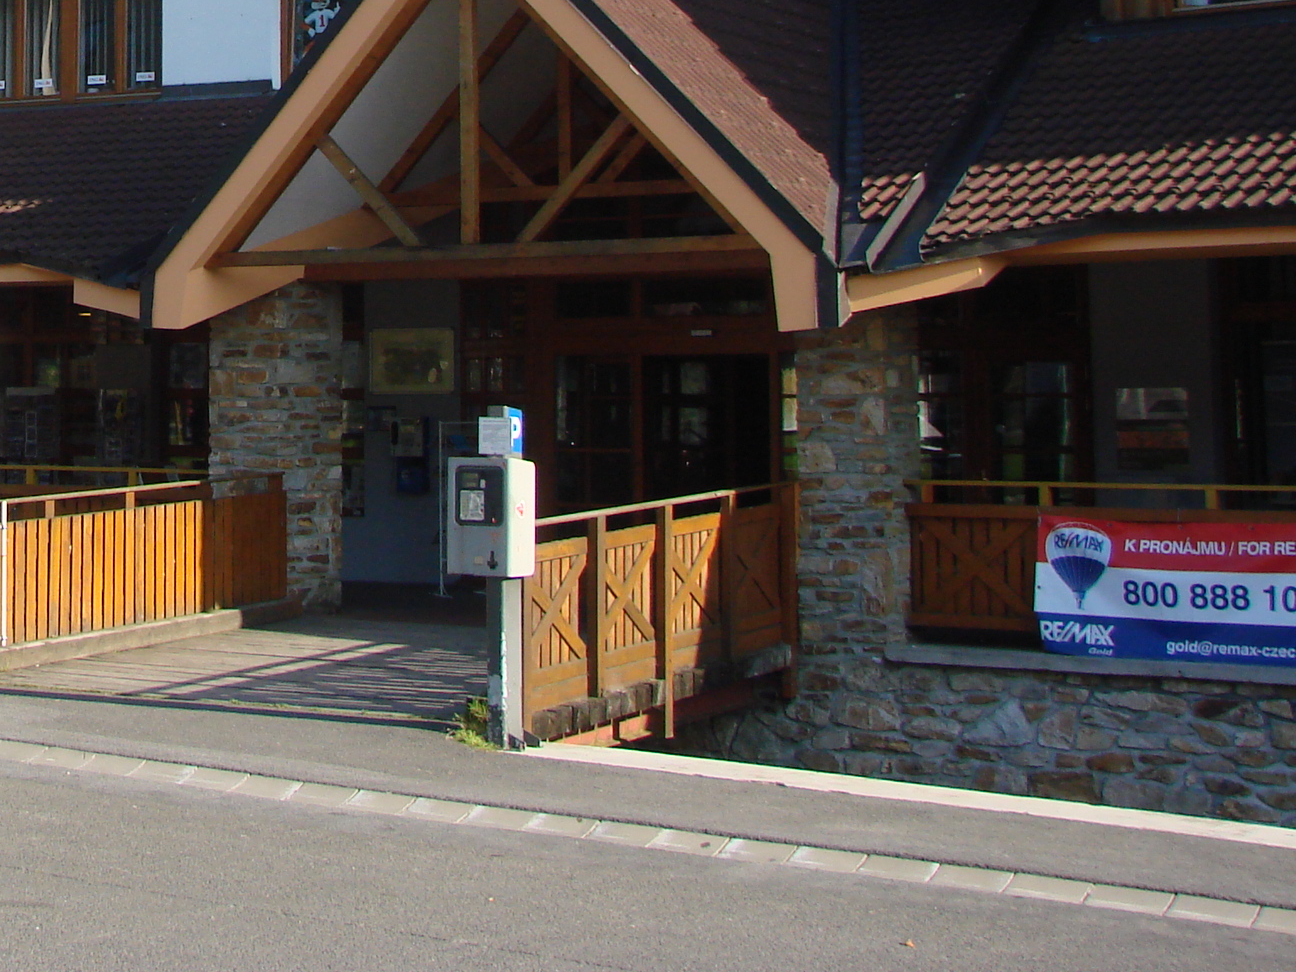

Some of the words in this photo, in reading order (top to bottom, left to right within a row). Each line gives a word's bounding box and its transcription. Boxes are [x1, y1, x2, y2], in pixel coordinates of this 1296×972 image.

[510, 416, 522, 447] P
[1054, 532, 1105, 554] RE/MAX
[1124, 538, 1136, 552] K
[1139, 536, 1226, 556] PRONÁJMU
[1237, 541, 1271, 556] FOR
[1122, 579, 1179, 608] 800
[1189, 583, 1251, 611] 888
[1262, 584, 1296, 613] 10
[1039, 619, 1115, 647] RE/MAX
